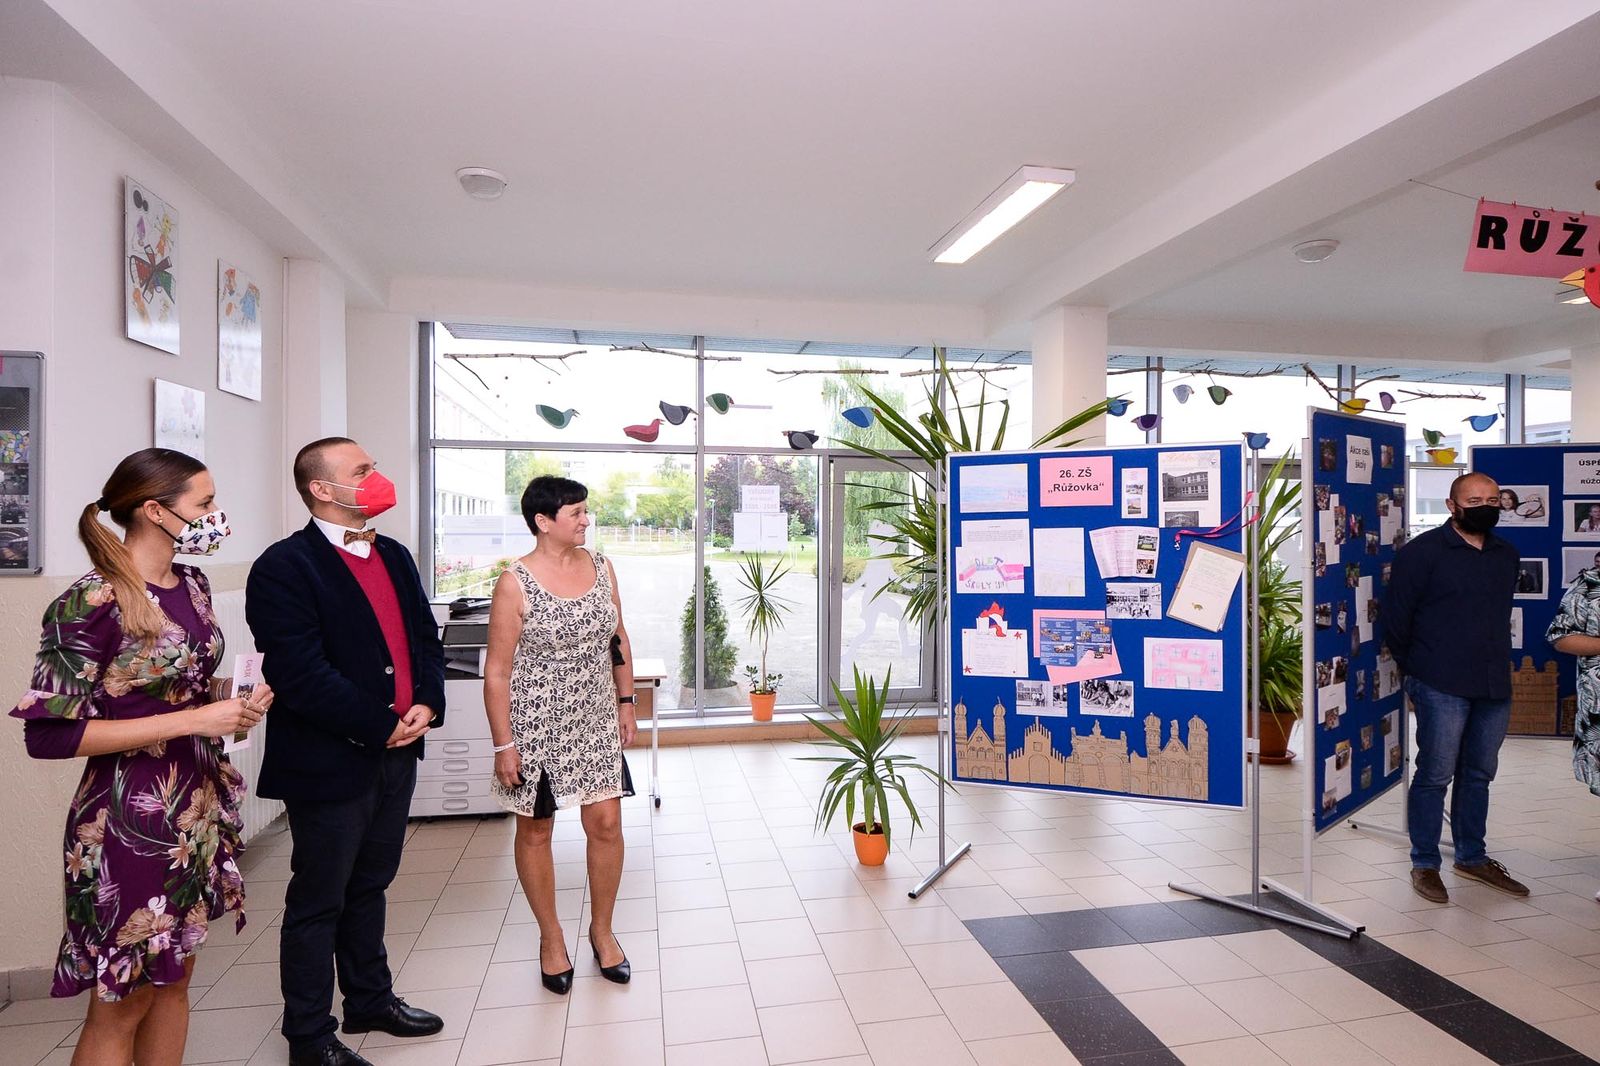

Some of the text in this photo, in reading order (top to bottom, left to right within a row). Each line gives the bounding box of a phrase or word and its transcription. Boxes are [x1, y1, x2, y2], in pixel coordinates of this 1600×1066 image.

[1477, 210, 1600, 257] RŮŽ
[1059, 466, 1092, 478] 26. ZŠ
